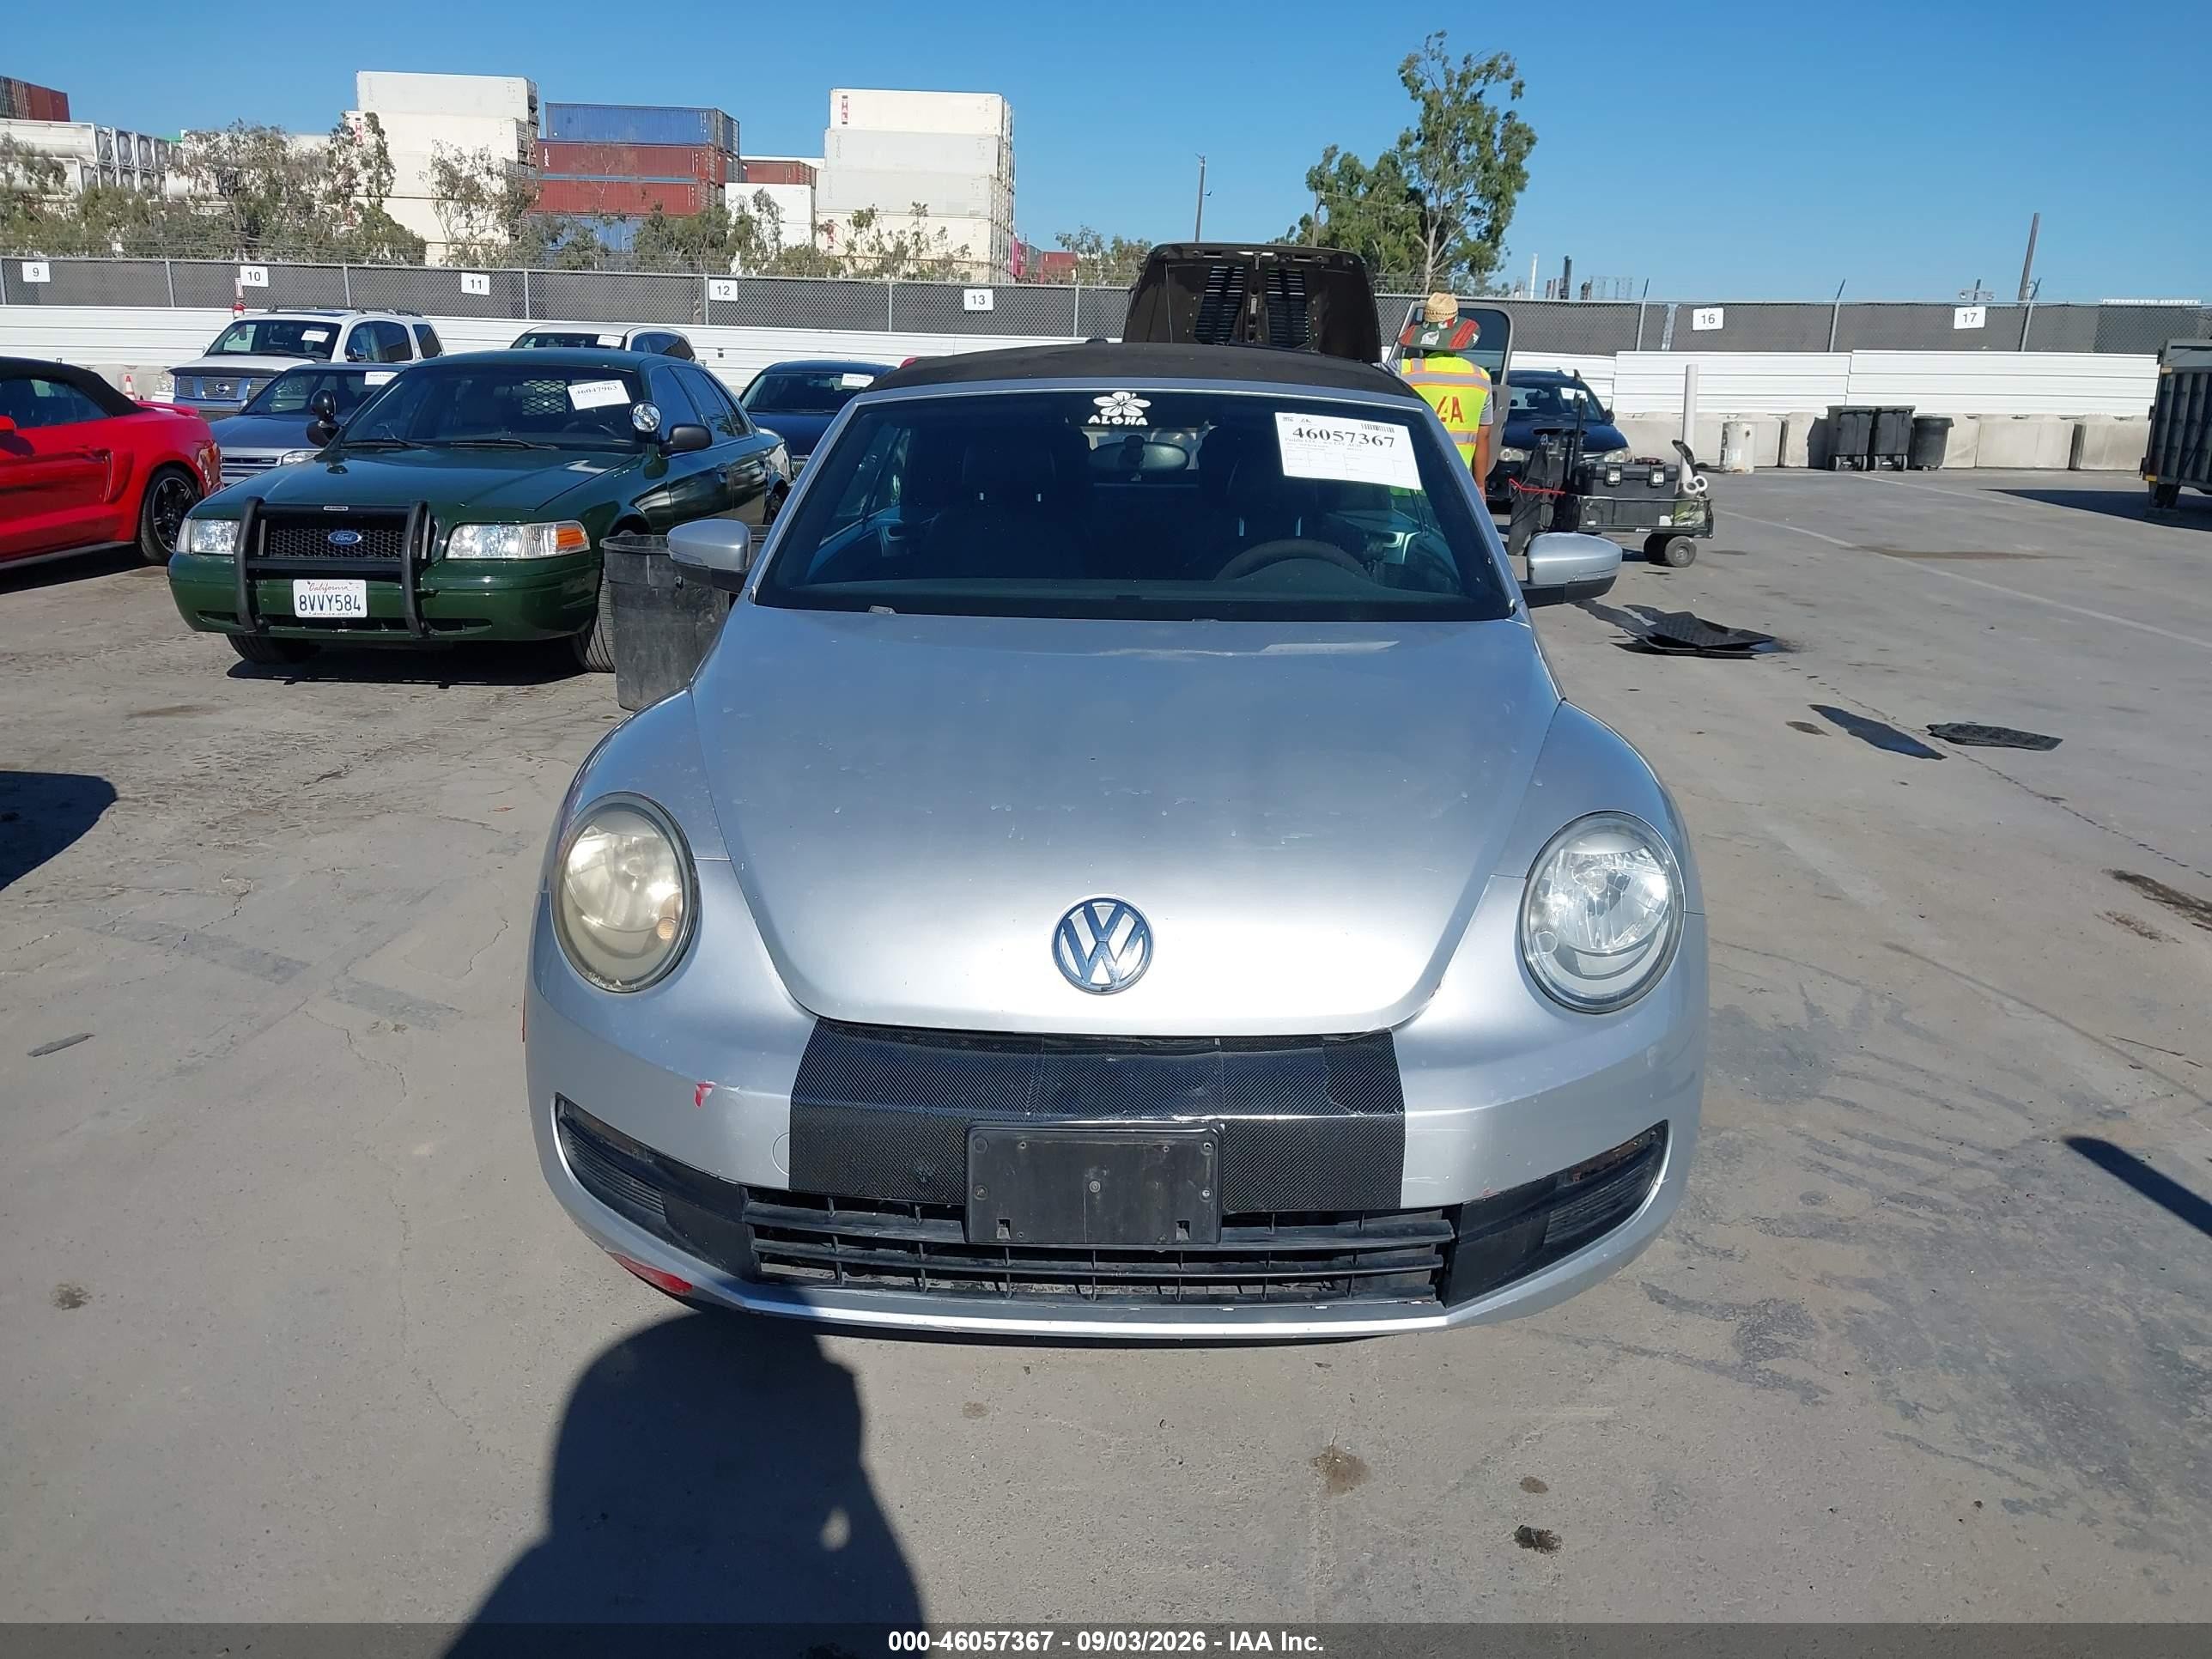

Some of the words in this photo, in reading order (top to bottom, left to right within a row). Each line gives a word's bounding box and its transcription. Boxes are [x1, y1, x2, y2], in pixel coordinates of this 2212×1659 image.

[33, 267, 40, 277] 9
[248, 270, 261, 282] 10
[470, 278, 483, 289] 11
[716, 284, 731, 295] 12
[971, 294, 986, 306] 13
[1701, 313, 1716, 325] 16
[1962, 312, 1978, 324] 17
[1087, 414, 1149, 427] ALOHA
[1292, 426, 1395, 448] 46057367
[308, 581, 350, 593] California
[298, 594, 362, 612] 8VVY584
